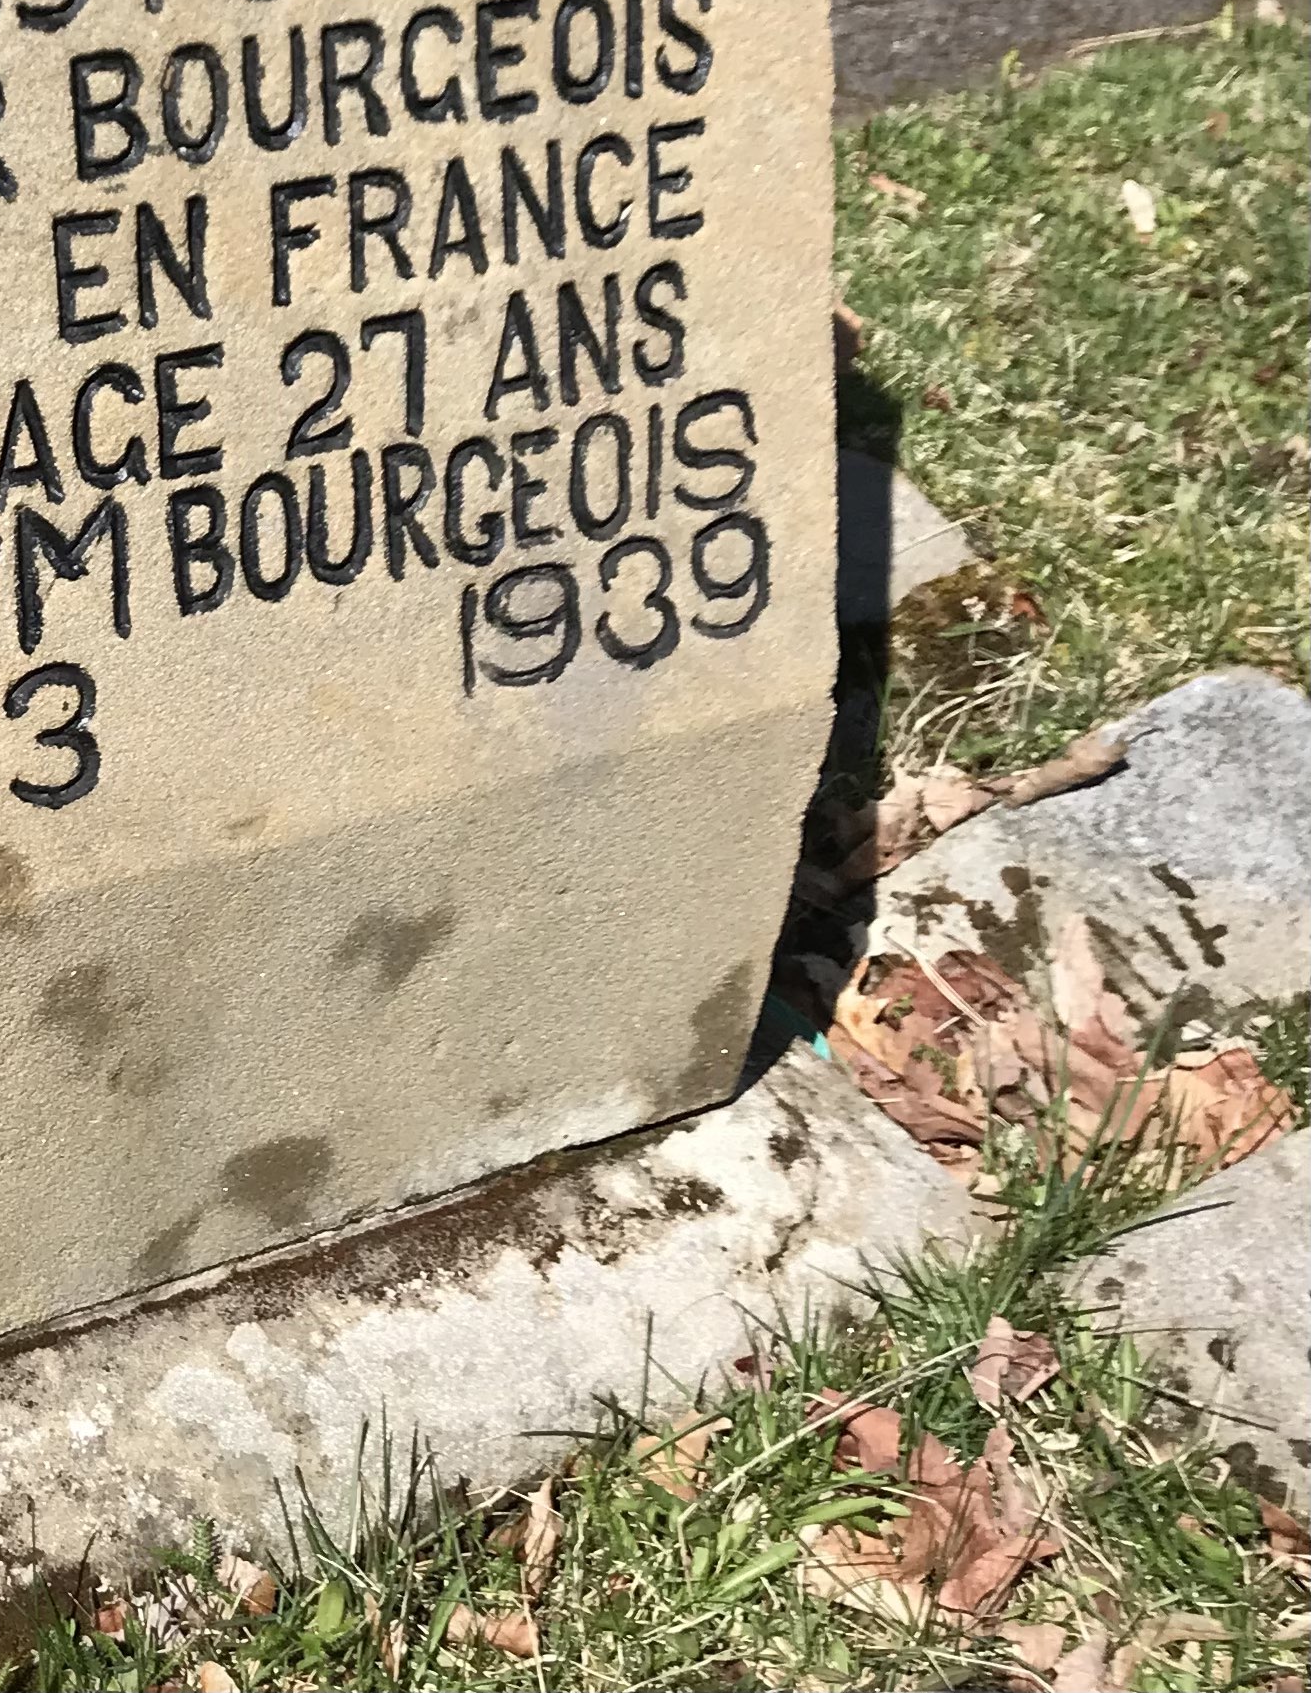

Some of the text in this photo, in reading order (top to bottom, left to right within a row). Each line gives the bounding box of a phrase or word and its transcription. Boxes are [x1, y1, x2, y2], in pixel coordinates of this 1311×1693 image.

[50, 192, 214, 348] EN
[268, 115, 707, 309] FRANCE
[278, 306, 429, 462] 27
[482, 259, 689, 423] ANS
[164, 388, 759, 619] BOURGEOIS
[457, 510, 773, 699] 1939
